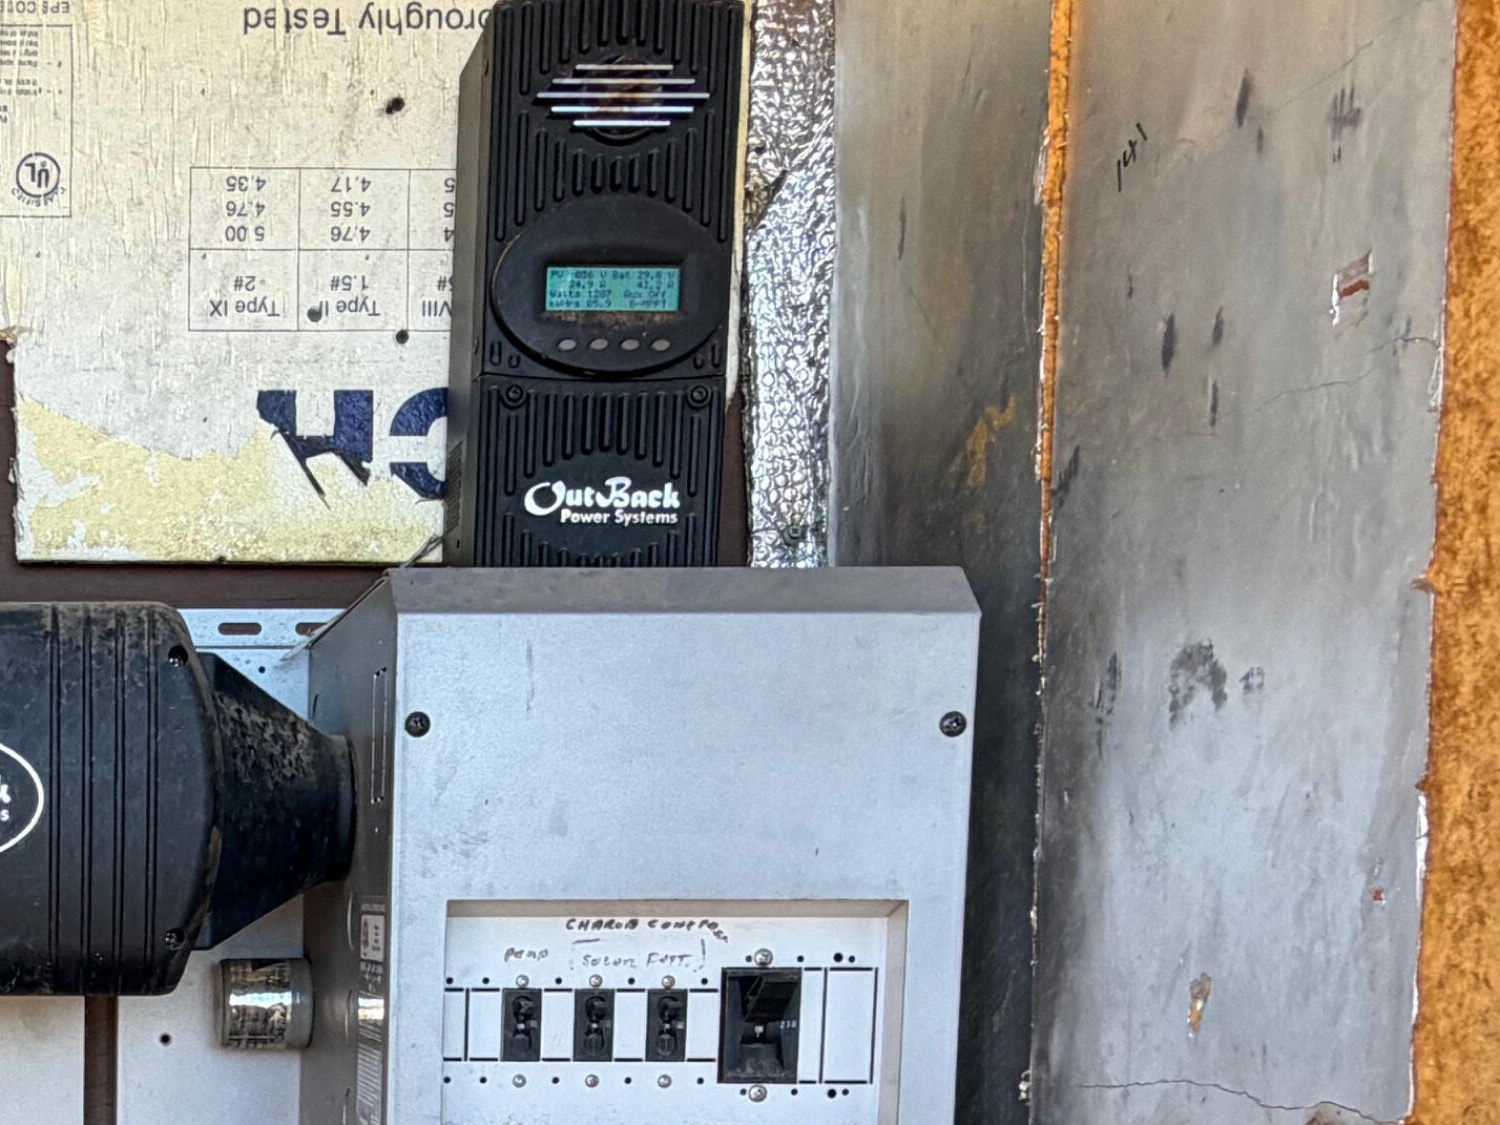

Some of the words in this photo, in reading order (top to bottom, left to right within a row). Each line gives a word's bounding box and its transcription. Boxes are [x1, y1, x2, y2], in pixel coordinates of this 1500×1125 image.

[243, 8, 346, 36] Tested
[225, 175, 267, 193] 4.35
[330, 176, 372, 193] 4.17
[225, 200, 266, 217] 4.76
[330, 200, 371, 218] 4.55
[330, 225, 371, 242] 4.76
[233, 275, 257, 292] 2#
[330, 275, 369, 292] 1.5#
[209, 300, 229, 317] IX
[234, 297, 281, 317] Type
[336, 297, 381, 317] Type
[524, 476, 681, 516] OutBack
[560, 508, 610, 524] Power
[614, 508, 678, 527] Systems
